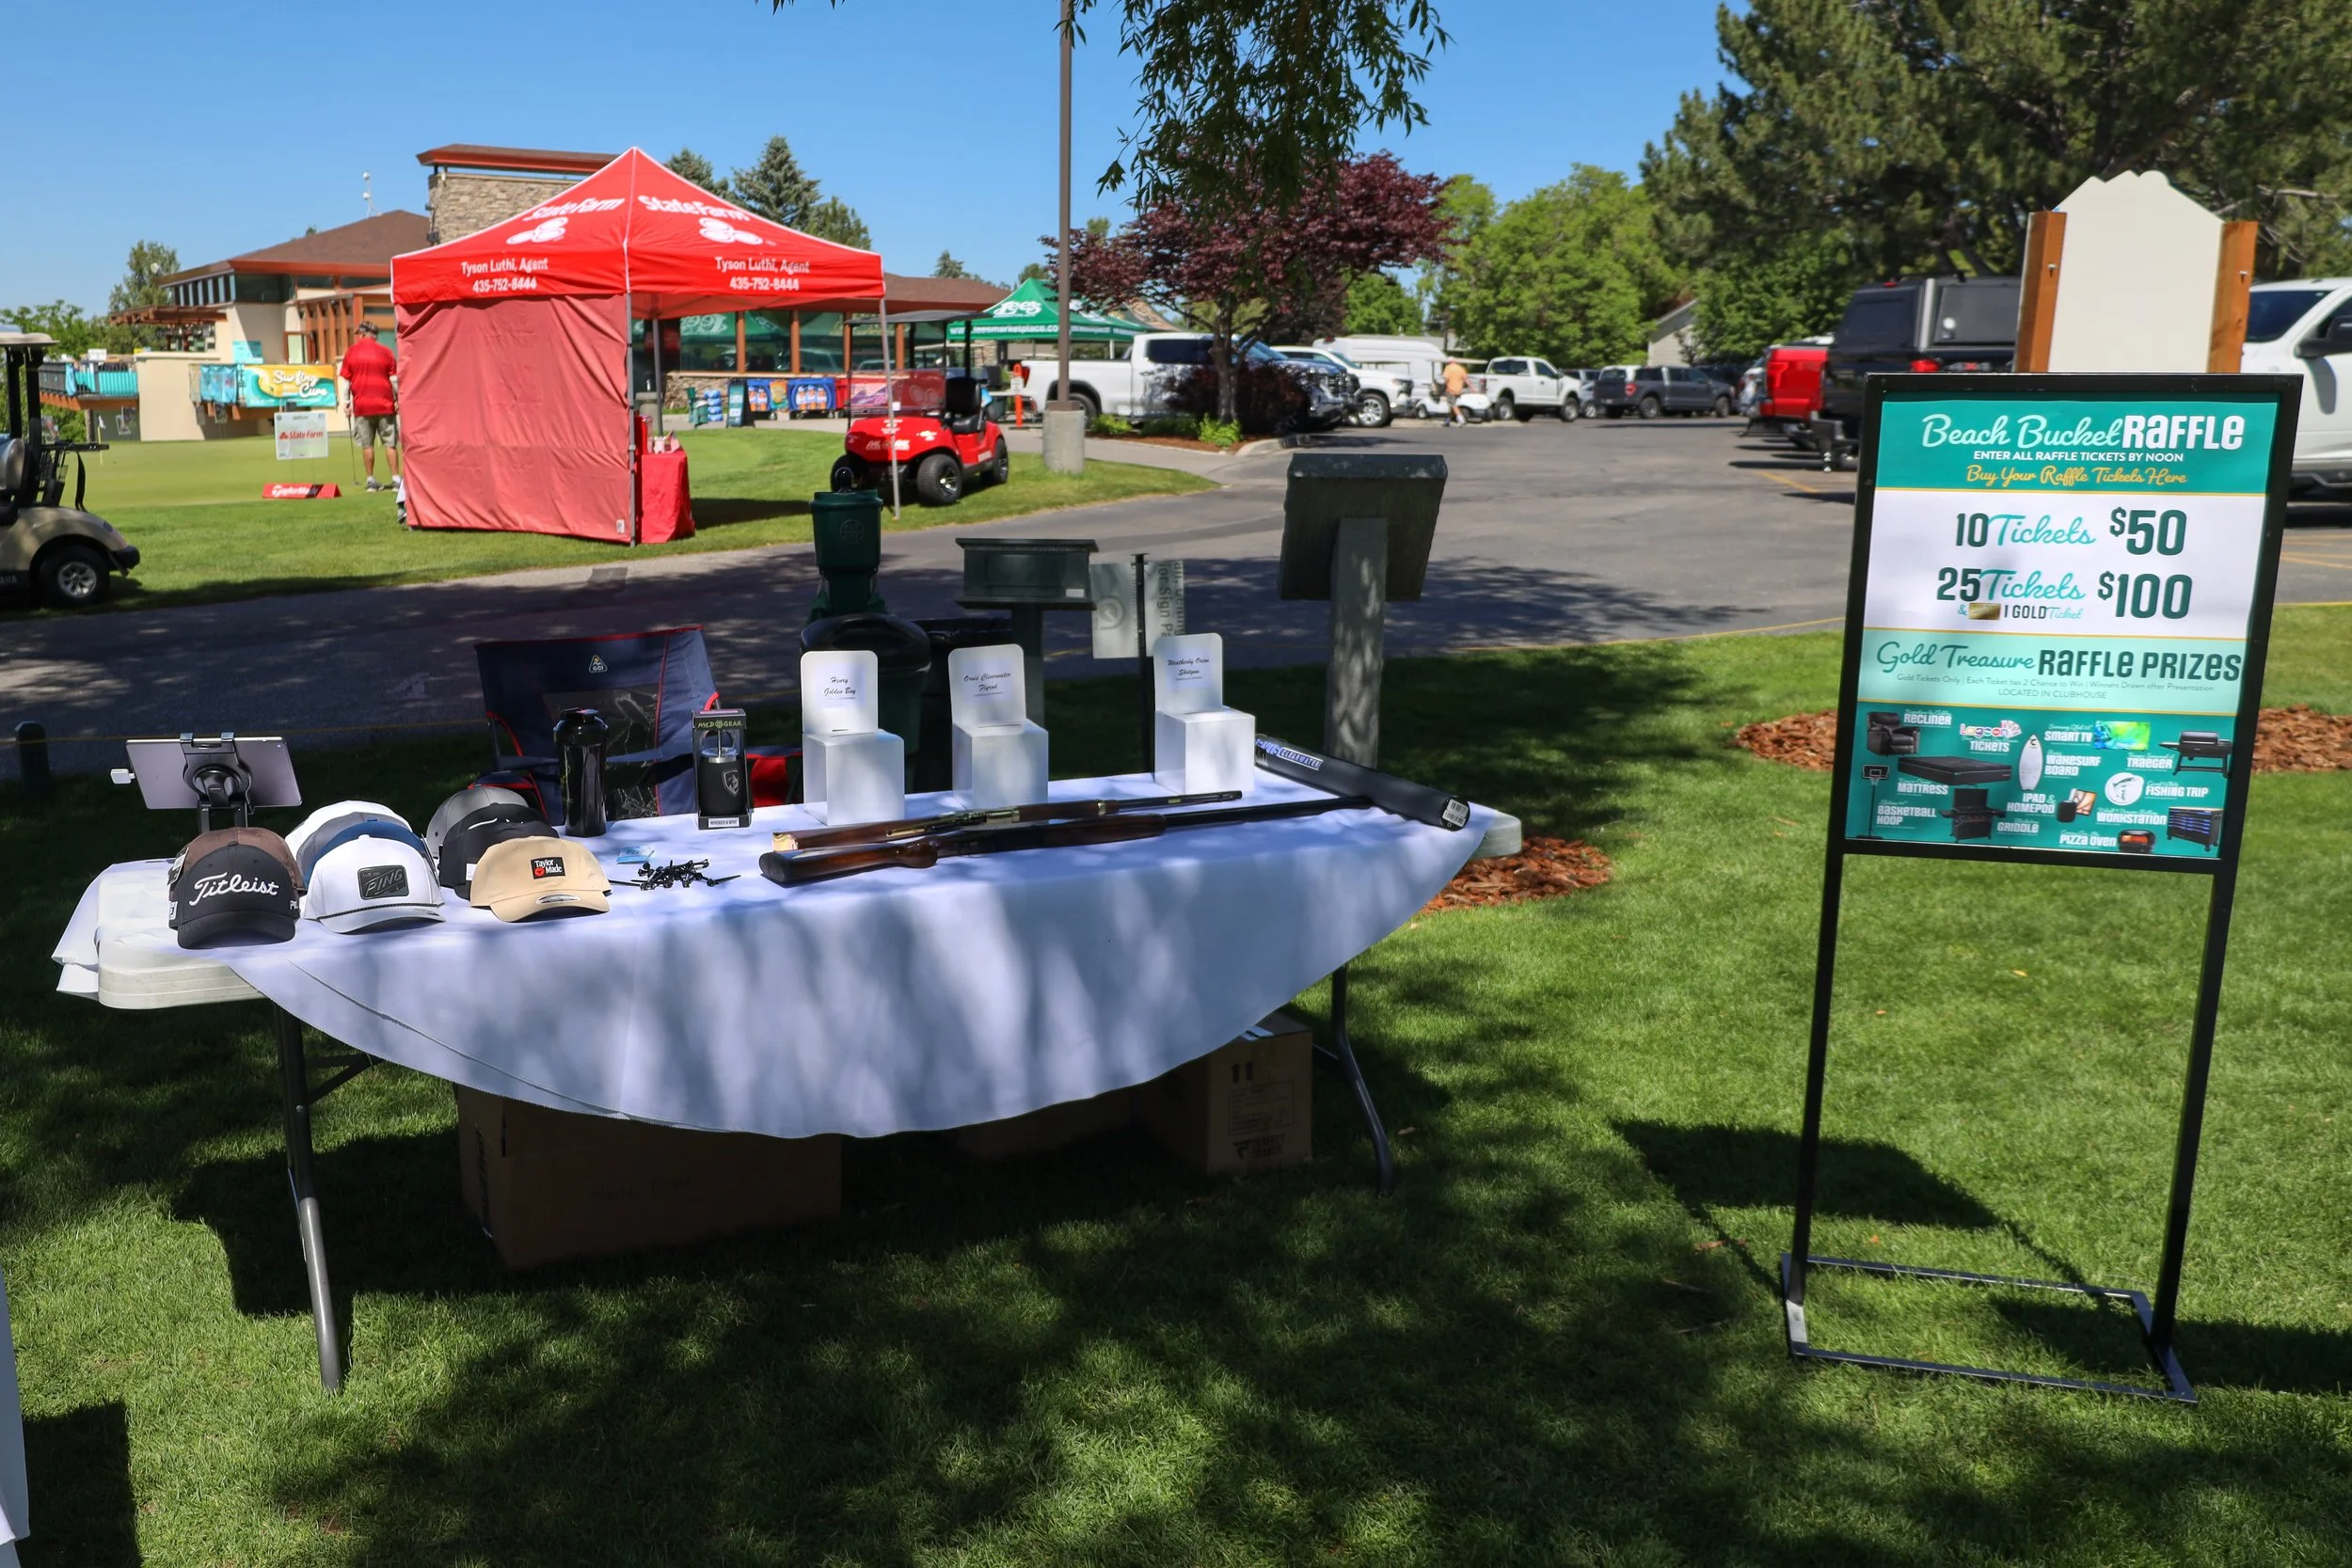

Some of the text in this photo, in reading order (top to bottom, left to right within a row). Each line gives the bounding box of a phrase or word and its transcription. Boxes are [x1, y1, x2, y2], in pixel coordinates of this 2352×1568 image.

[461, 257, 548, 277] Tyson Luthi, Agent
[715, 256, 810, 275] Tyson Luthi, Agent
[472, 277, 537, 293] 435-752-8444
[729, 277, 800, 292] 435-752-8444
[273, 370, 320, 388] Surfing
[299, 384, 328, 398] Cure
[306, 430, 324, 439] Farm
[1921, 413, 2245, 450] Beach Bucket RAFFLE
[1974, 451, 2184, 463] ENTER ALL RAFFLE TICKETS BY NOON
[1966, 465, 2187, 487] Buy Your Raffle Tickets Here
[1955, 506, 2187, 556] 10 Tickets $50
[1936, 566, 2193, 620] 25 Tickets $100
[1156, 586, 1172, 618] Sign
[2004, 604, 2009, 618] 1
[2011, 605, 2047, 619] GOLD
[2045, 606, 2084, 619] Ticket
[1877, 641, 2242, 681] Gold Treasure RAFFLE PRIZES
[830, 676, 849, 685] Henry
[980, 672, 1011, 682] Clearwater
[1897, 673, 1915, 682] Gold
[1915, 673, 1941, 683] Tickets
[1943, 675, 1961, 685] Only
[1966, 676, 1984, 685] Each
[1985, 677, 2008, 686] Ticket
[2029, 679, 2058, 688] Chance
[2121, 681, 2145, 689] Drawn
[2146, 681, 2165, 689] after
[2167, 683, 2214, 691] Presentation
[824, 687, 856, 696] Golden Boy
[1998, 688, 2040, 697] LOCATED
[2053, 689, 2107, 699] CLUBHOUSE
[1903, 713, 1952, 726] RECLINER
[1960, 723, 2009, 738] Lagoon
[2044, 730, 2093, 743] SMART TV
[1970, 741, 2010, 752] TICKETS
[2045, 754, 2102, 767] WAKESURF
[2126, 757, 2173, 769] TRAEGER
[2044, 765, 2079, 777] BOARD
[1897, 783, 1948, 795] MATTRESS
[2145, 785, 2209, 799] FISHING TRIP
[2022, 793, 2045, 803] IPAD
[1877, 804, 1937, 817] BASKETBALL
[2006, 802, 2056, 815] HOMEPOD
[1876, 816, 1903, 826] HOOP
[2096, 812, 2168, 826] WORKSTATION
[1996, 821, 2040, 833] GRIDDLE
[2059, 833, 2117, 847] PIZZA OVEN
[534, 859, 554, 869] Taylor
[546, 863, 563, 874] Made
[365, 868, 403, 896] PING
[188, 872, 279, 907] Titleist
